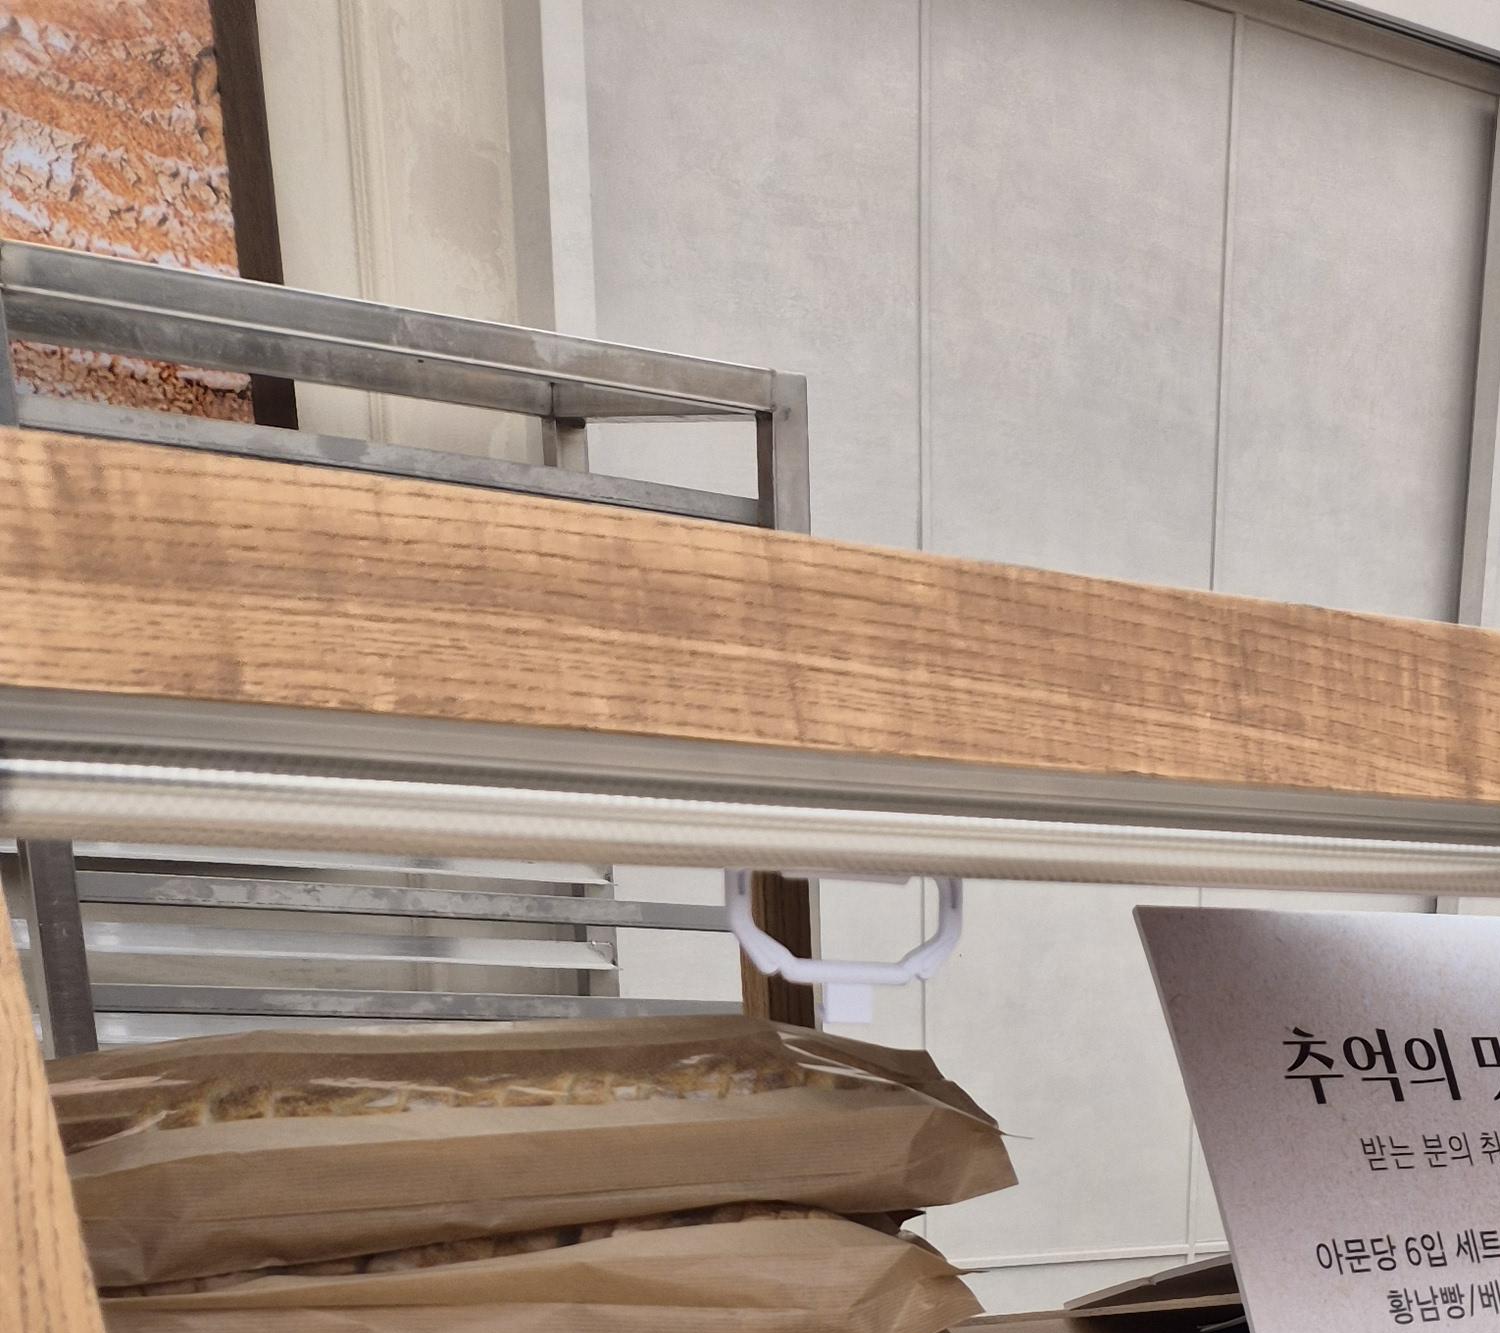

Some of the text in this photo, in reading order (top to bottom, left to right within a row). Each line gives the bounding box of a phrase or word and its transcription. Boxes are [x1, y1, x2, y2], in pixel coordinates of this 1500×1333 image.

[1283, 1027, 1462, 1104] 추억의
[1360, 1134, 1415, 1171] 받는
[1421, 1131, 1474, 1169] 분의
[1315, 1234, 1398, 1275] 아문당
[1405, 1230, 1448, 1268] 6입
